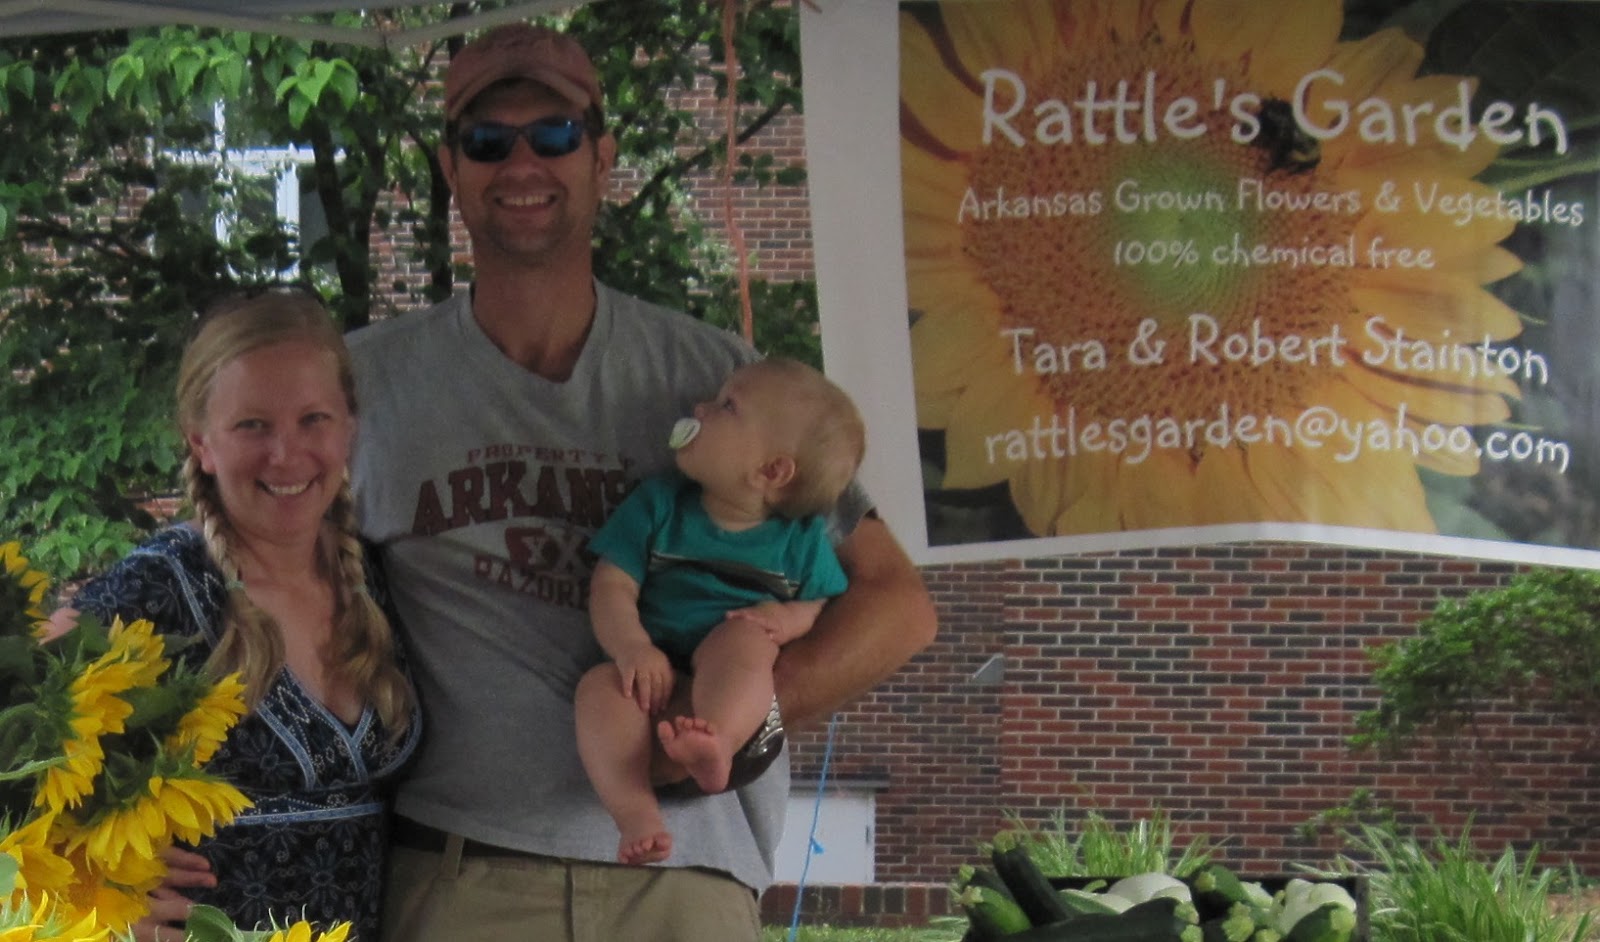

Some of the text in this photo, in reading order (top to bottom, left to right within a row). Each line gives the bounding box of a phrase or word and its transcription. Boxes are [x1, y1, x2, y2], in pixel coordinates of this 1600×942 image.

[980, 68, 1568, 155] Rattle's Garden
[957, 179, 1585, 228] Arkansas Grown Flowers & Vegetables
[1113, 236, 1436, 271] 100% chemical free
[1000, 312, 1550, 386] Tara & Robert Stainton
[984, 402, 1571, 475] rattlesgarden@yahoo.com
